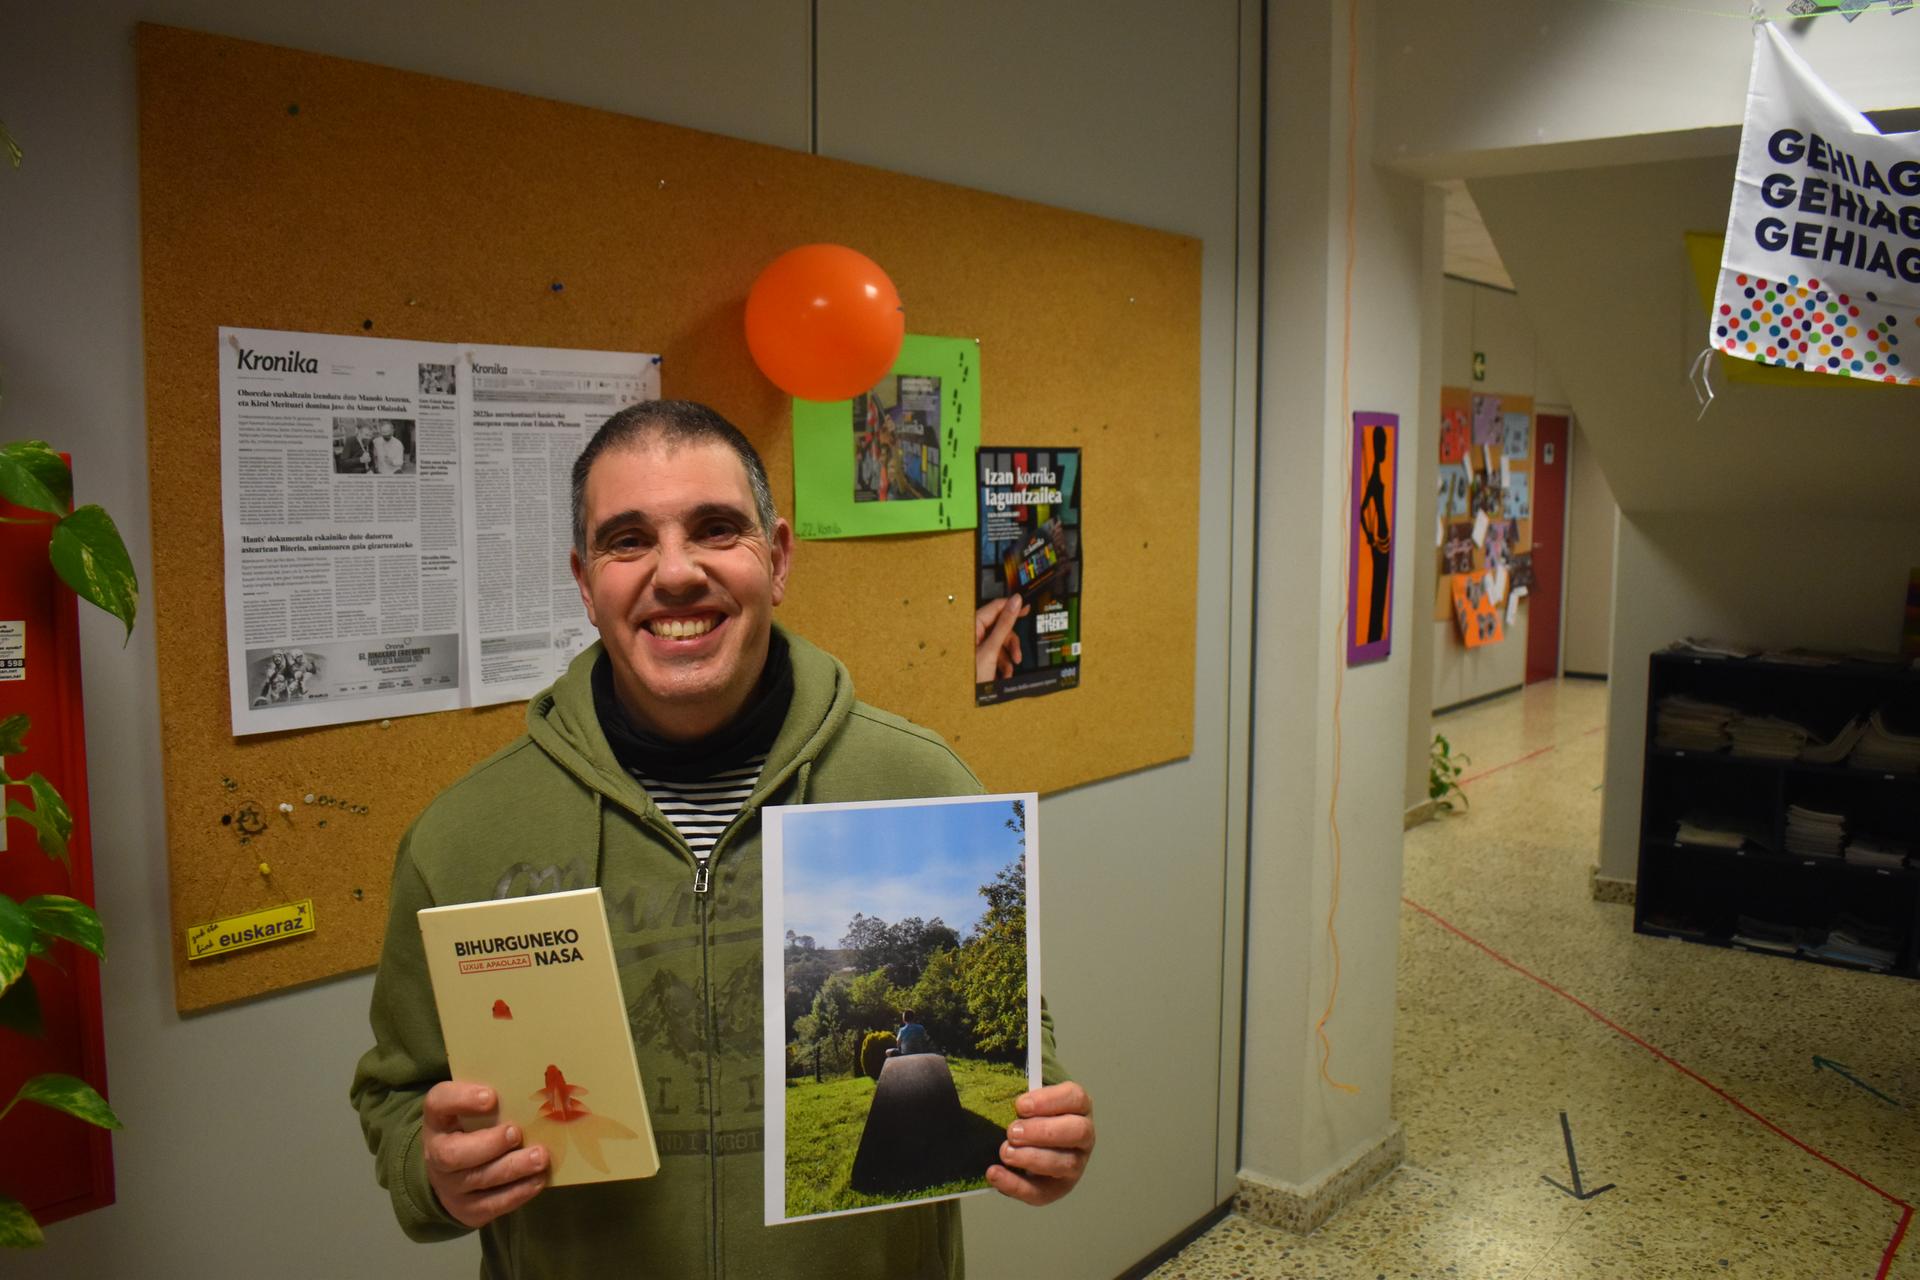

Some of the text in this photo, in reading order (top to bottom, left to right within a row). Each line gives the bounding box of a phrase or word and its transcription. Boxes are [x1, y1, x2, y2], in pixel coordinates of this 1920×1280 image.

[1768, 128, 1920, 196] GEHIAG
[237, 349, 319, 374] Kronika
[472, 363, 508, 375] Kronika
[984, 466, 1056, 485] Izan korrika
[985, 486, 1062, 511] laguntzailea
[219, 917, 304, 947] euskaraz
[454, 928, 579, 957] BIHURGUNEKO
[462, 958, 528, 972] UXUE APAOLAZA
[534, 947, 584, 966] NASA
